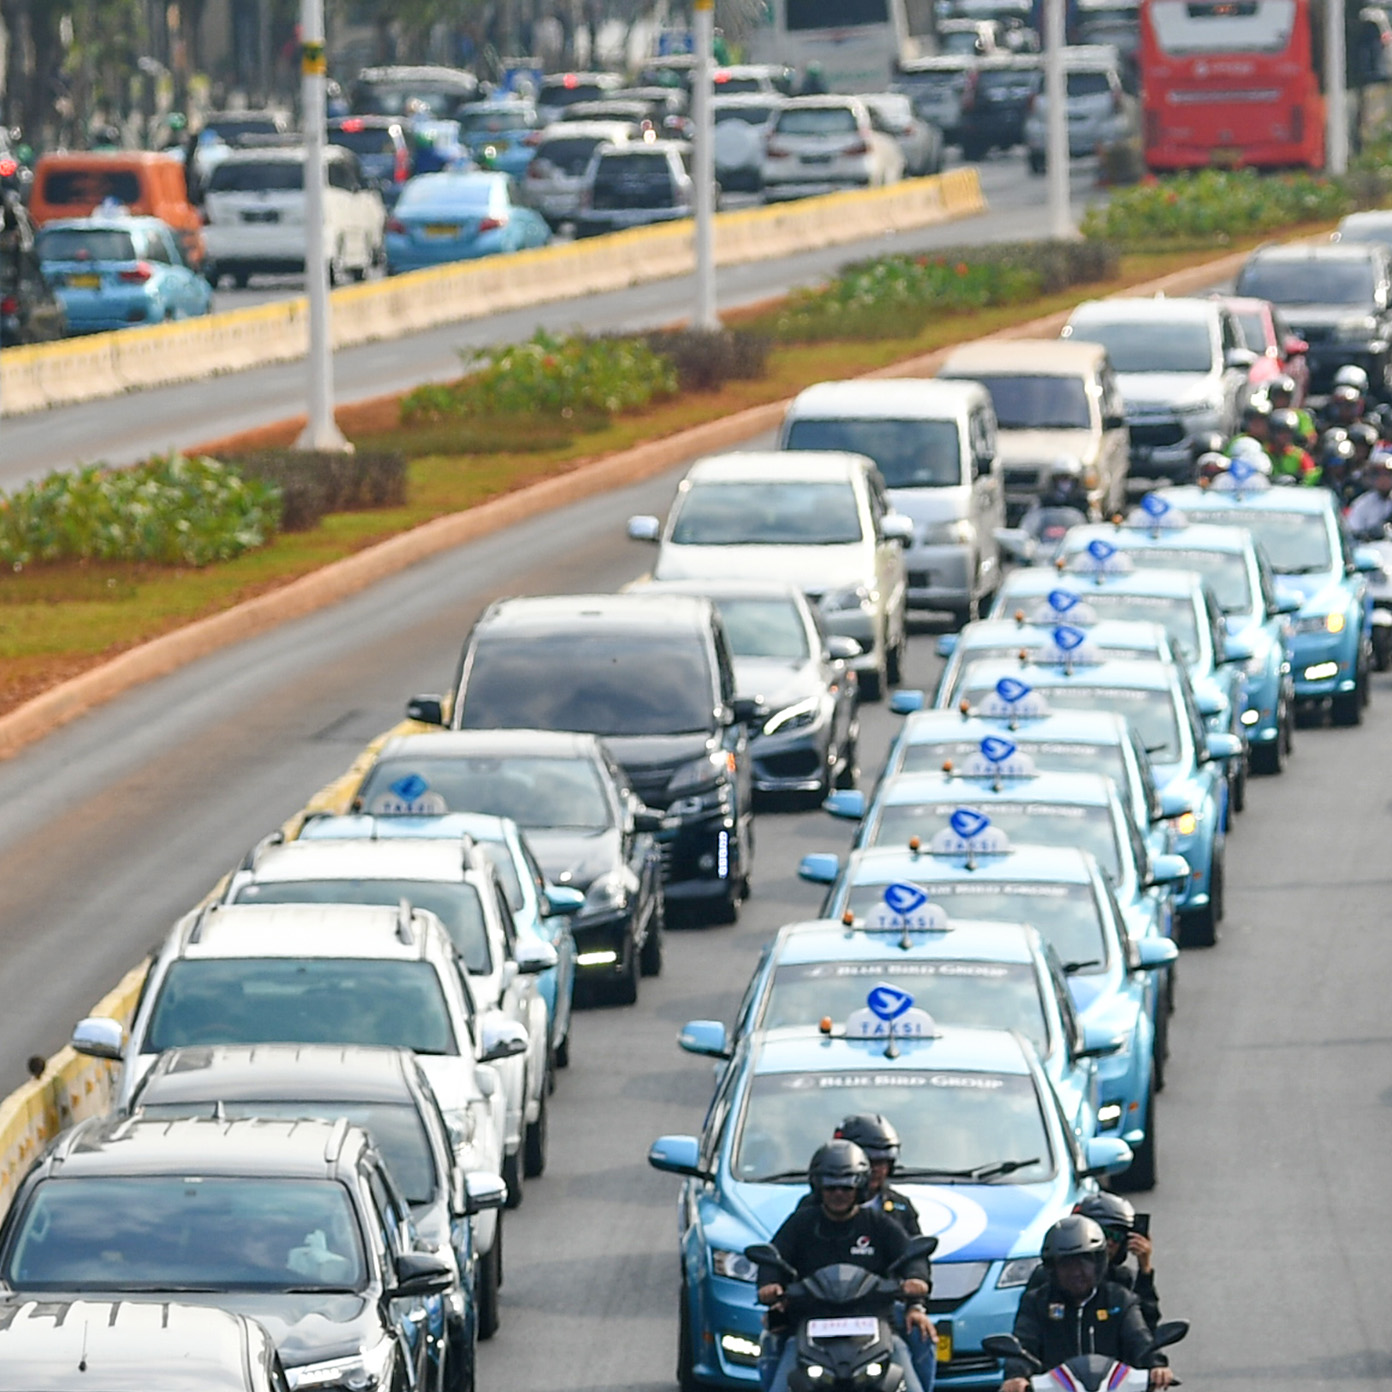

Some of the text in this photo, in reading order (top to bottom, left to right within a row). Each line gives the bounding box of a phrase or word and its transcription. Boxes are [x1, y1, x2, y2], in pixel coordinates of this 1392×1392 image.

[879, 915, 936, 929] TAKSI
[836, 965, 1009, 978] BLUE BIRD GROUP
[860, 1021, 922, 1035] TAKSI
[819, 1075, 1004, 1089] BLUE BIRD GROUP
